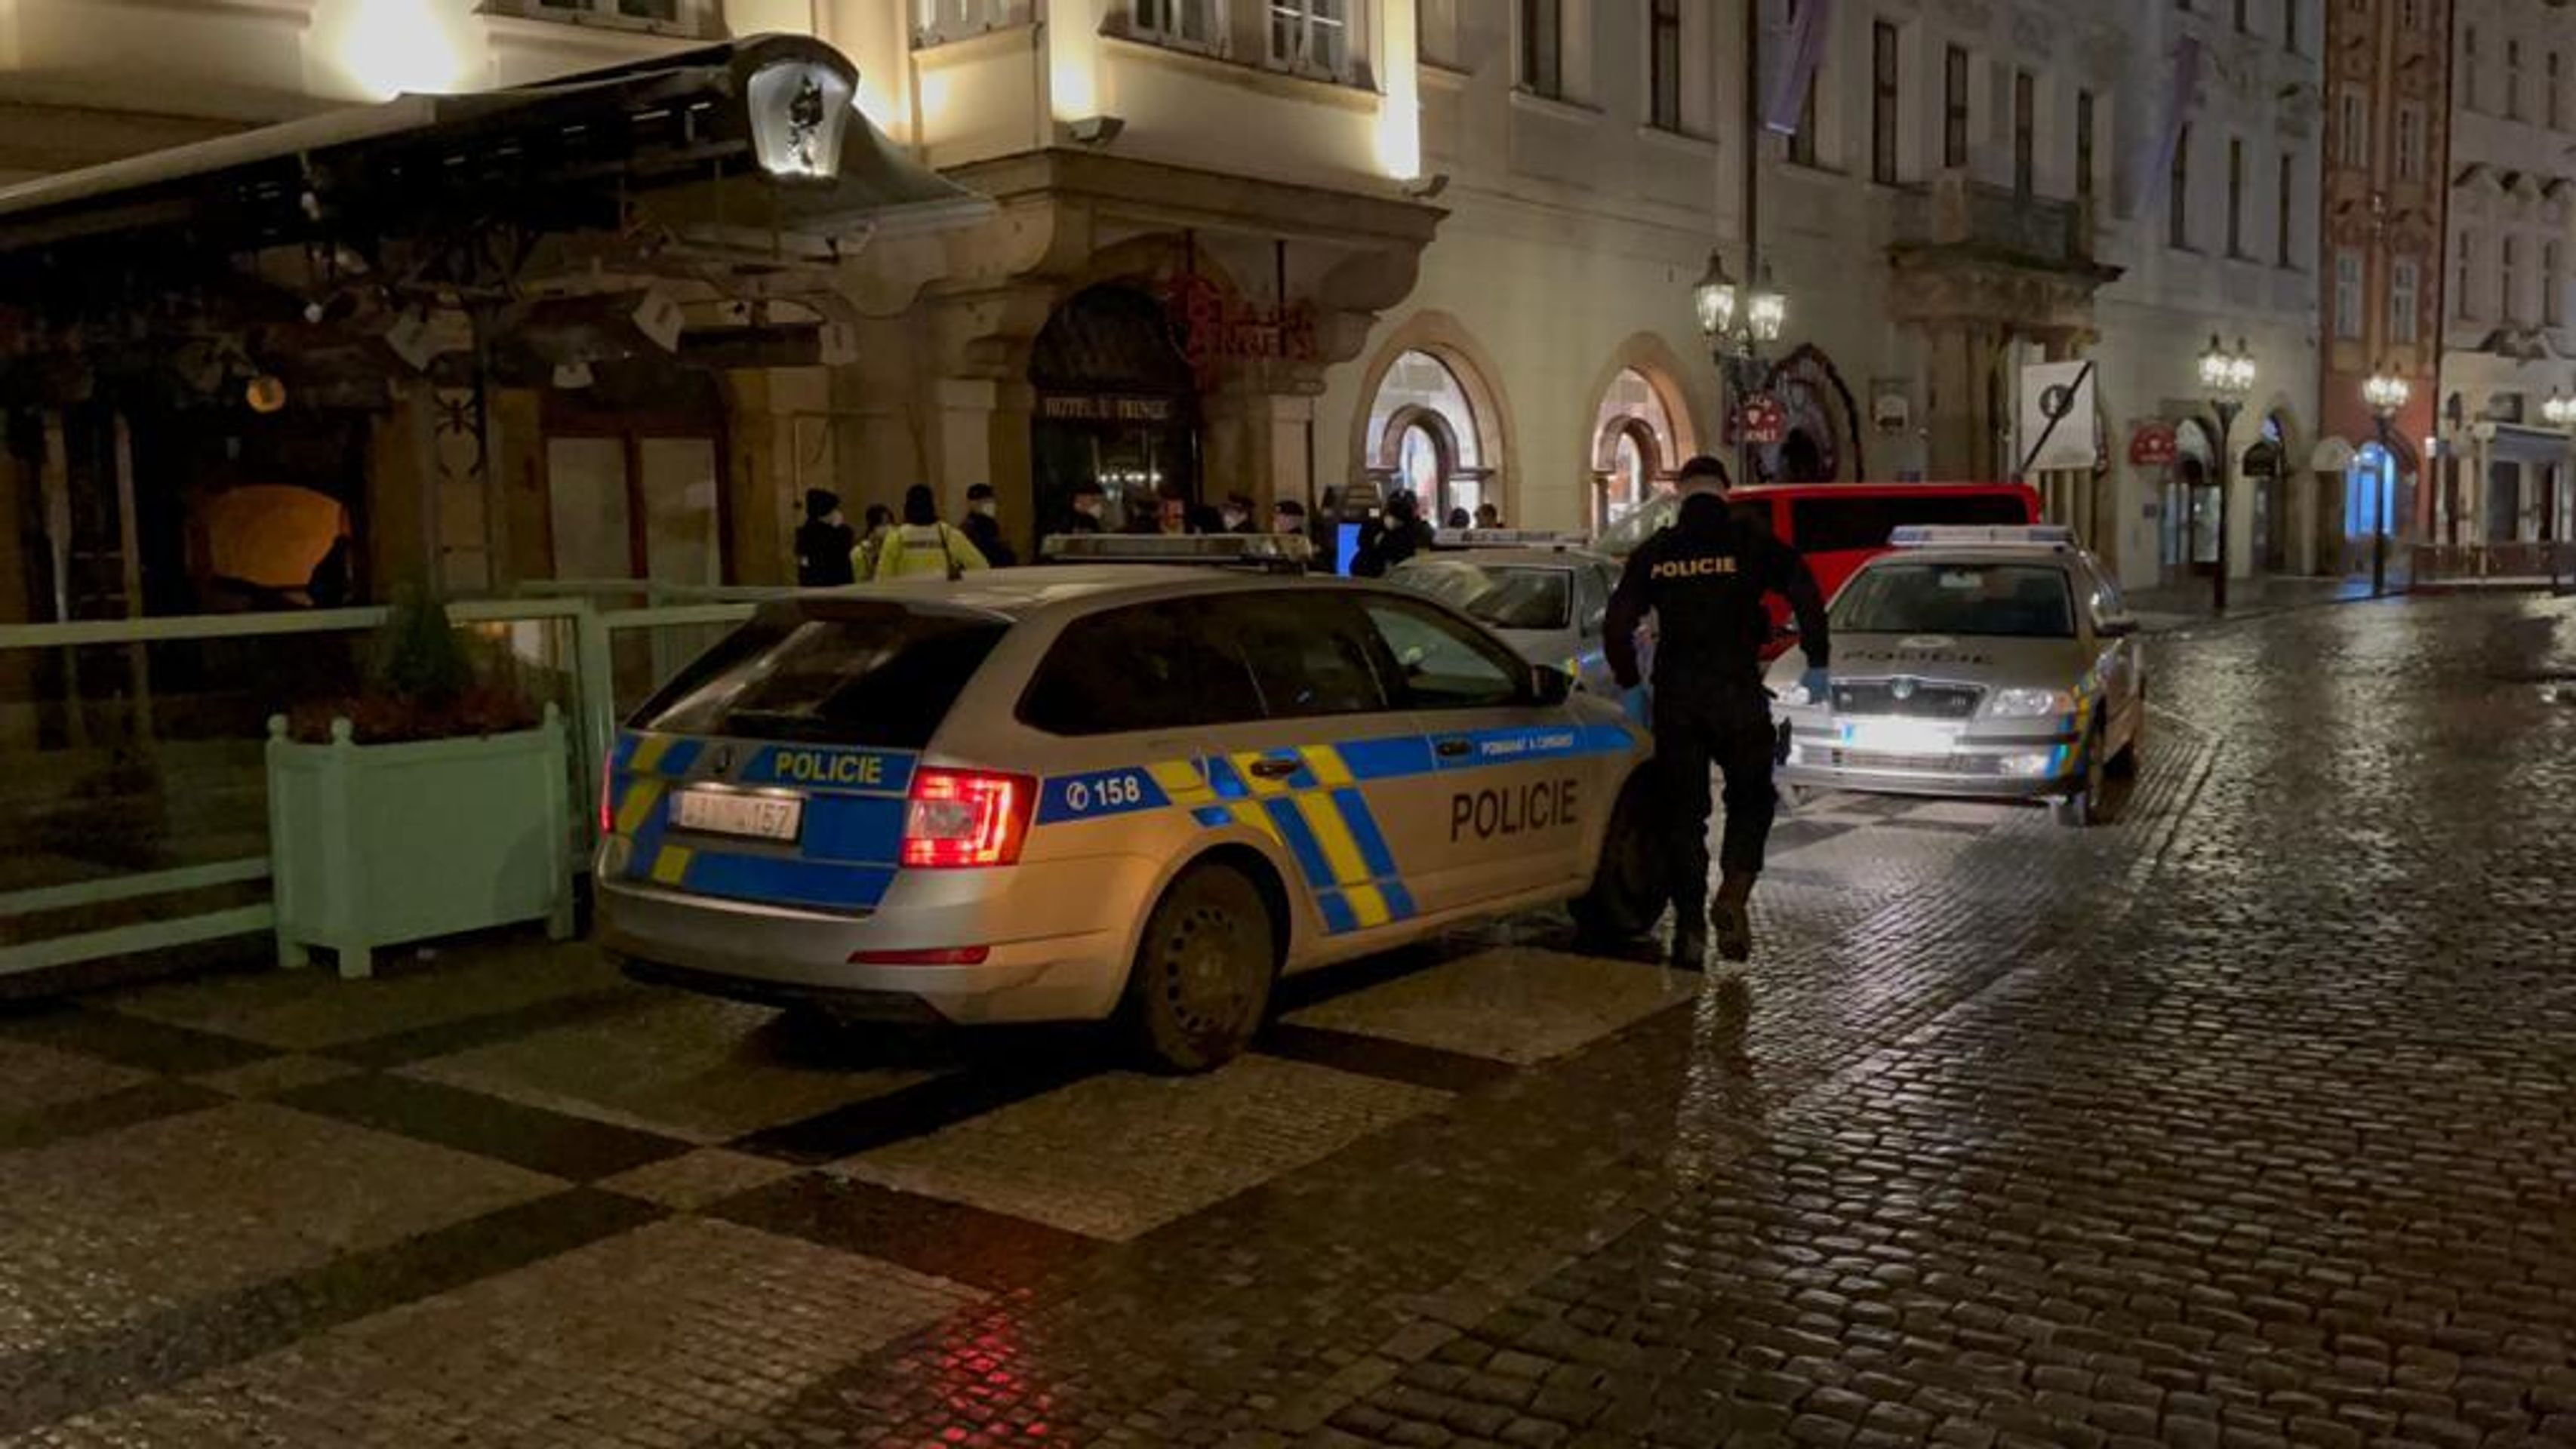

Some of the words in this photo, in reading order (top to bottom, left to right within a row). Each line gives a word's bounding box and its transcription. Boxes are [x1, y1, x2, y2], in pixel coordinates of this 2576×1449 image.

[1651, 556, 1737, 580] POLICIE
[775, 751, 882, 783] POLICIE
[1094, 775, 1140, 806] 158
[1451, 780, 1577, 842] POLICIE
